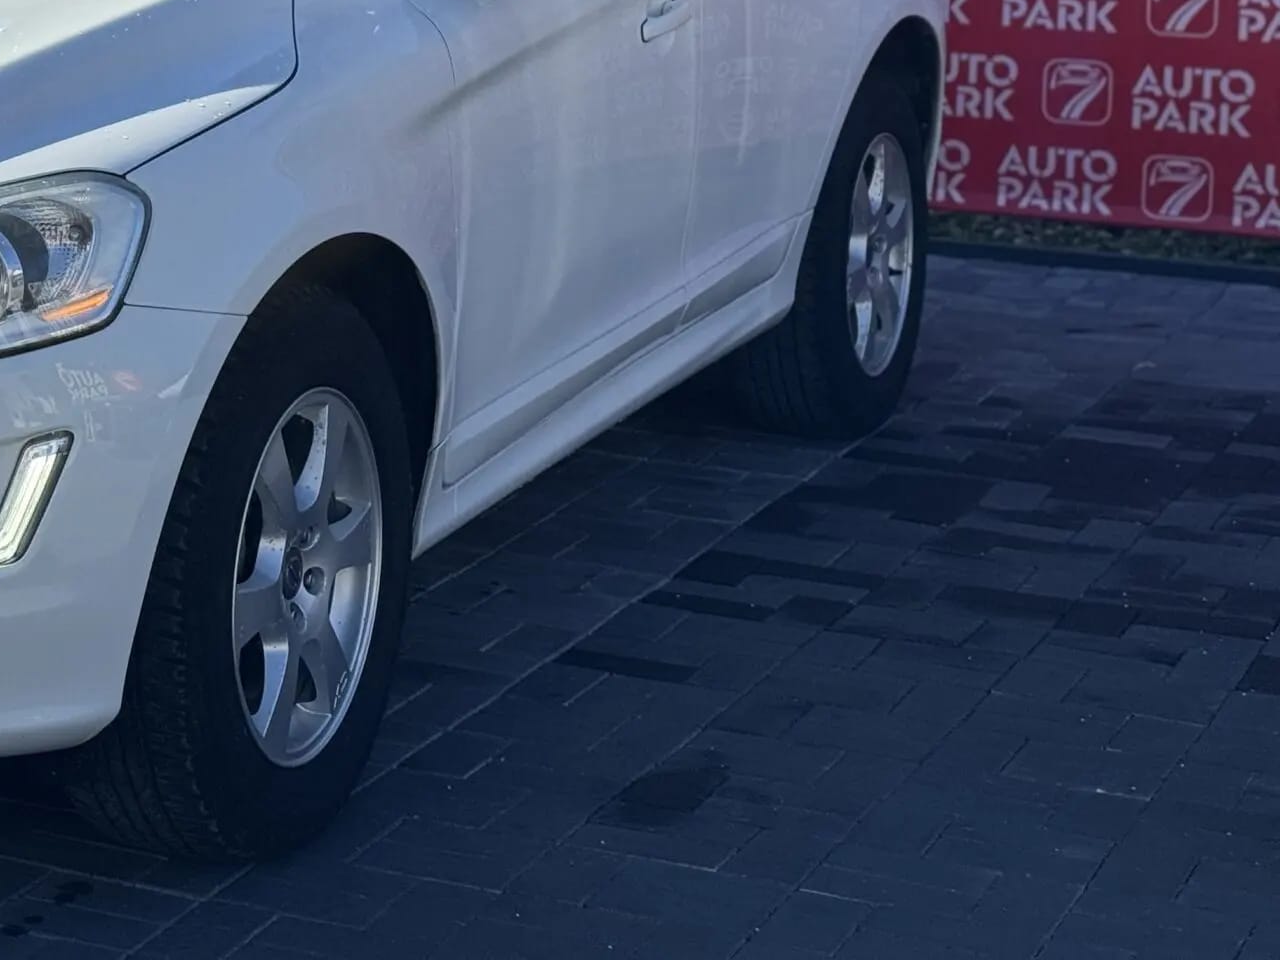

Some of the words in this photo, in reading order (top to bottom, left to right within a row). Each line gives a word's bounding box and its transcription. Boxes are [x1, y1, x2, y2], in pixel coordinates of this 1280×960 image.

[1132, 65, 1255, 103] AUTO
[1132, 98, 1250, 136] PARK
[998, 144, 1117, 183] AUTO
[996, 177, 1112, 215] PARK
